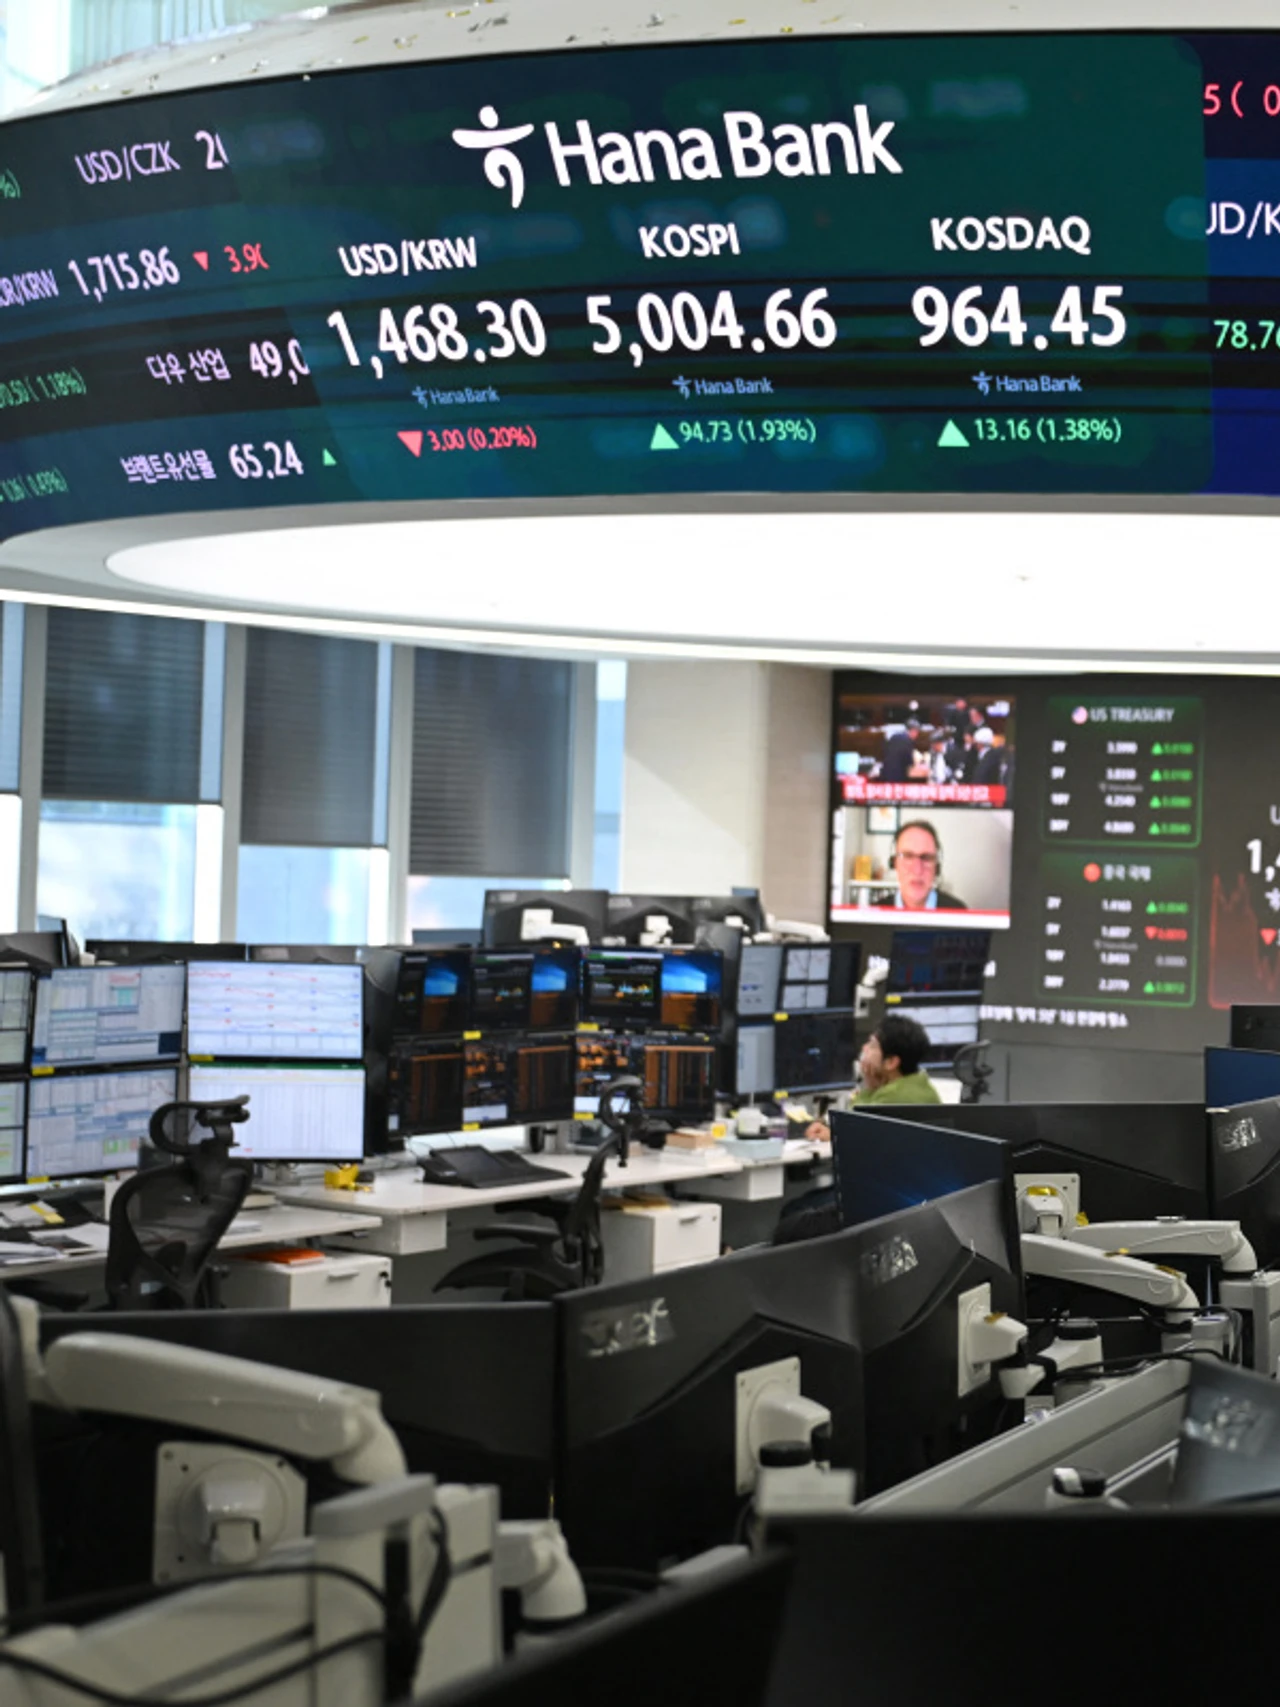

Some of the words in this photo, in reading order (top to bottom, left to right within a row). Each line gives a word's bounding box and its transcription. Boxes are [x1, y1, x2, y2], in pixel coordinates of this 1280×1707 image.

[75, 141, 180, 184] USD/CZK
[639, 223, 740, 258] KOSPI
[931, 216, 1091, 255] KOSDAQ
[68, 246, 180, 302] 1,715.86
[338, 237, 476, 276] USD/KRW
[587, 288, 837, 367] 5,004.66
[912, 286, 1126, 350] 964.45
[327, 299, 546, 379] 1,468.30
[146, 353, 186, 384] 다우
[189, 349, 231, 381] 산업
[428, 430, 465, 450] 3.00
[468, 426, 536, 450] (0.20%)
[677, 421, 732, 447] 94.73
[738, 419, 816, 443] (1.93%)
[975, 419, 1031, 440] 13.16
[1037, 418, 1121, 442] (1.38%)
[121, 450, 216, 483] 브렌트유선물
[229, 441, 303, 479] 65.24
[1088, 708, 1107, 721] US
[1111, 708, 1173, 721] TREASURY
